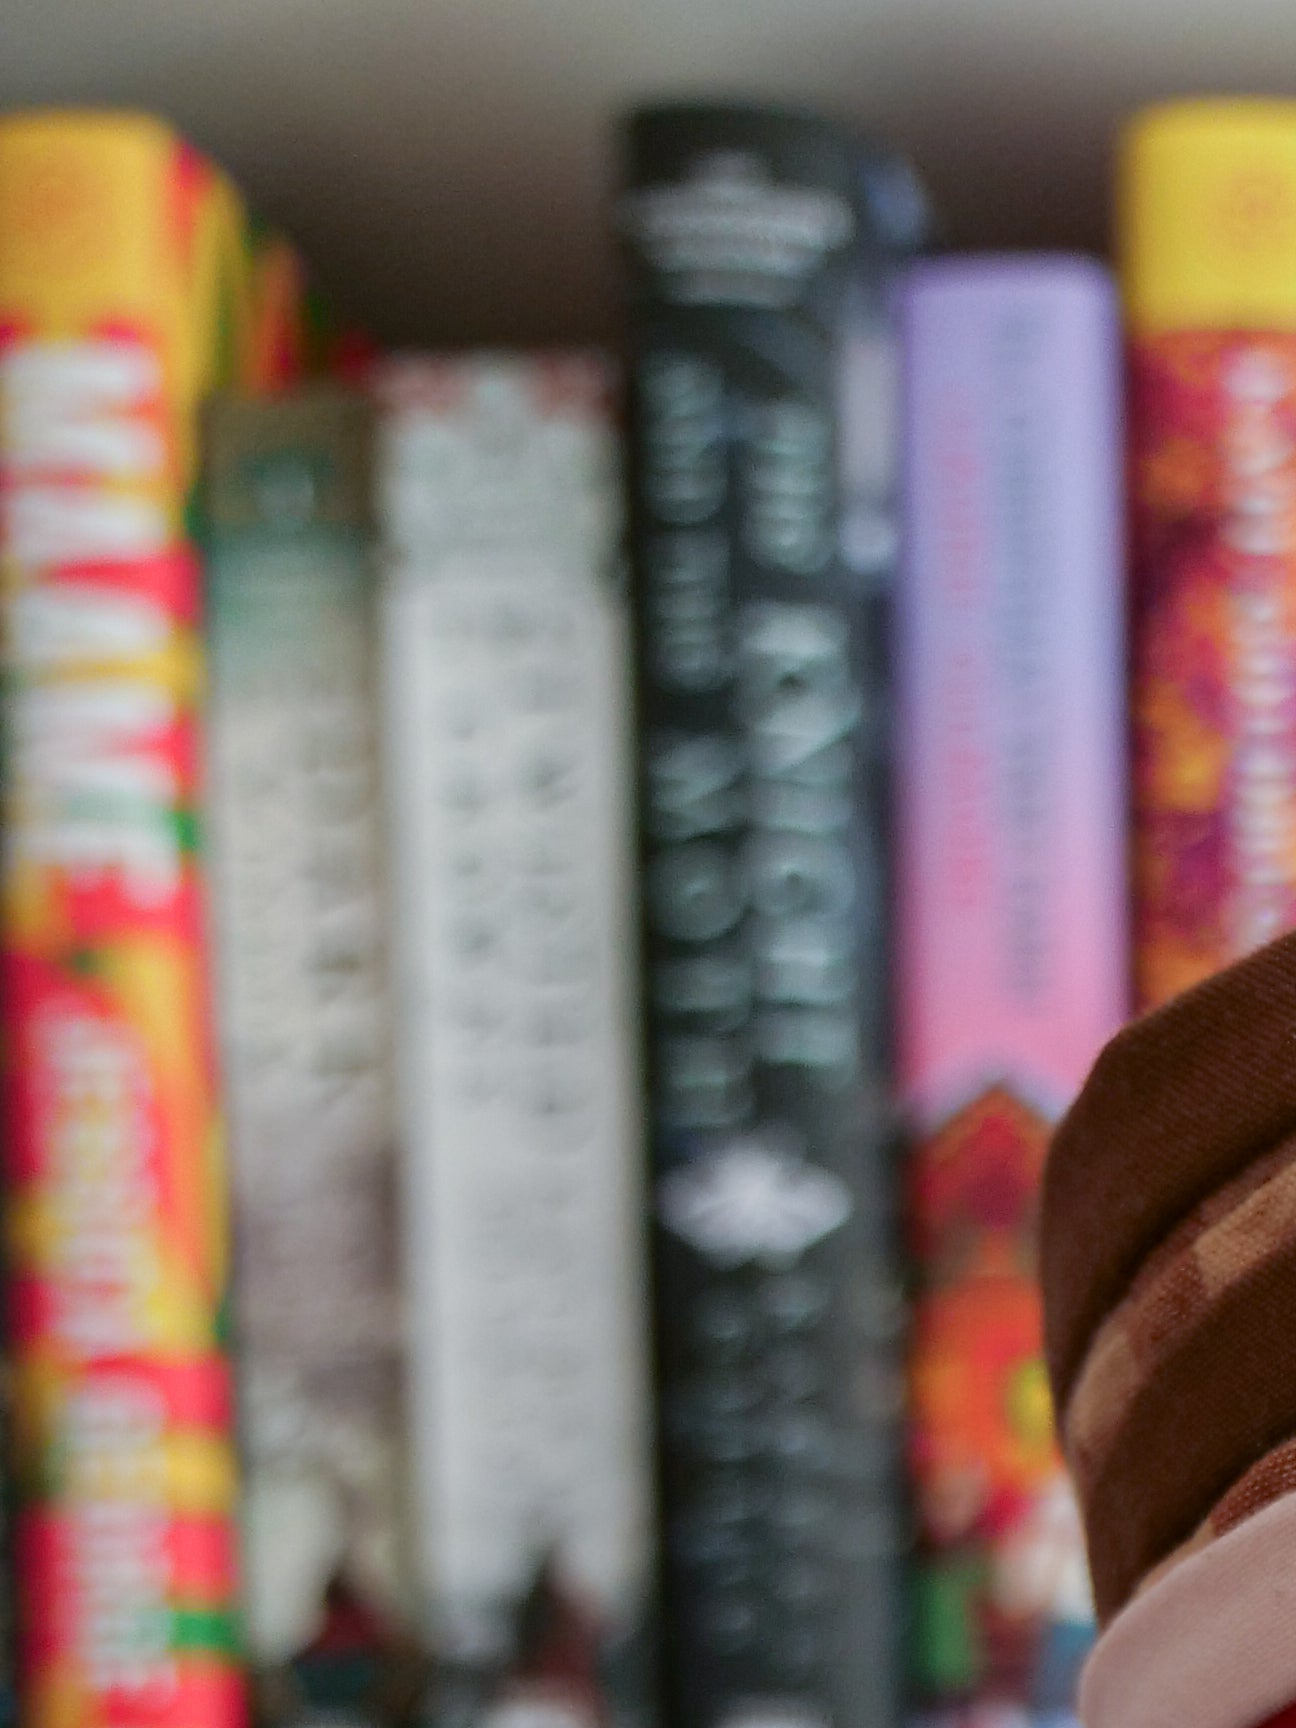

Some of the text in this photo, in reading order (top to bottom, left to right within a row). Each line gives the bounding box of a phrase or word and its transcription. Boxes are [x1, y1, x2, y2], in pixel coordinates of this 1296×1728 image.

[8, 340, 181, 907] MAAME
[739, 603, 868, 1080] KNIGHT
[643, 730, 758, 1132] MOTH
